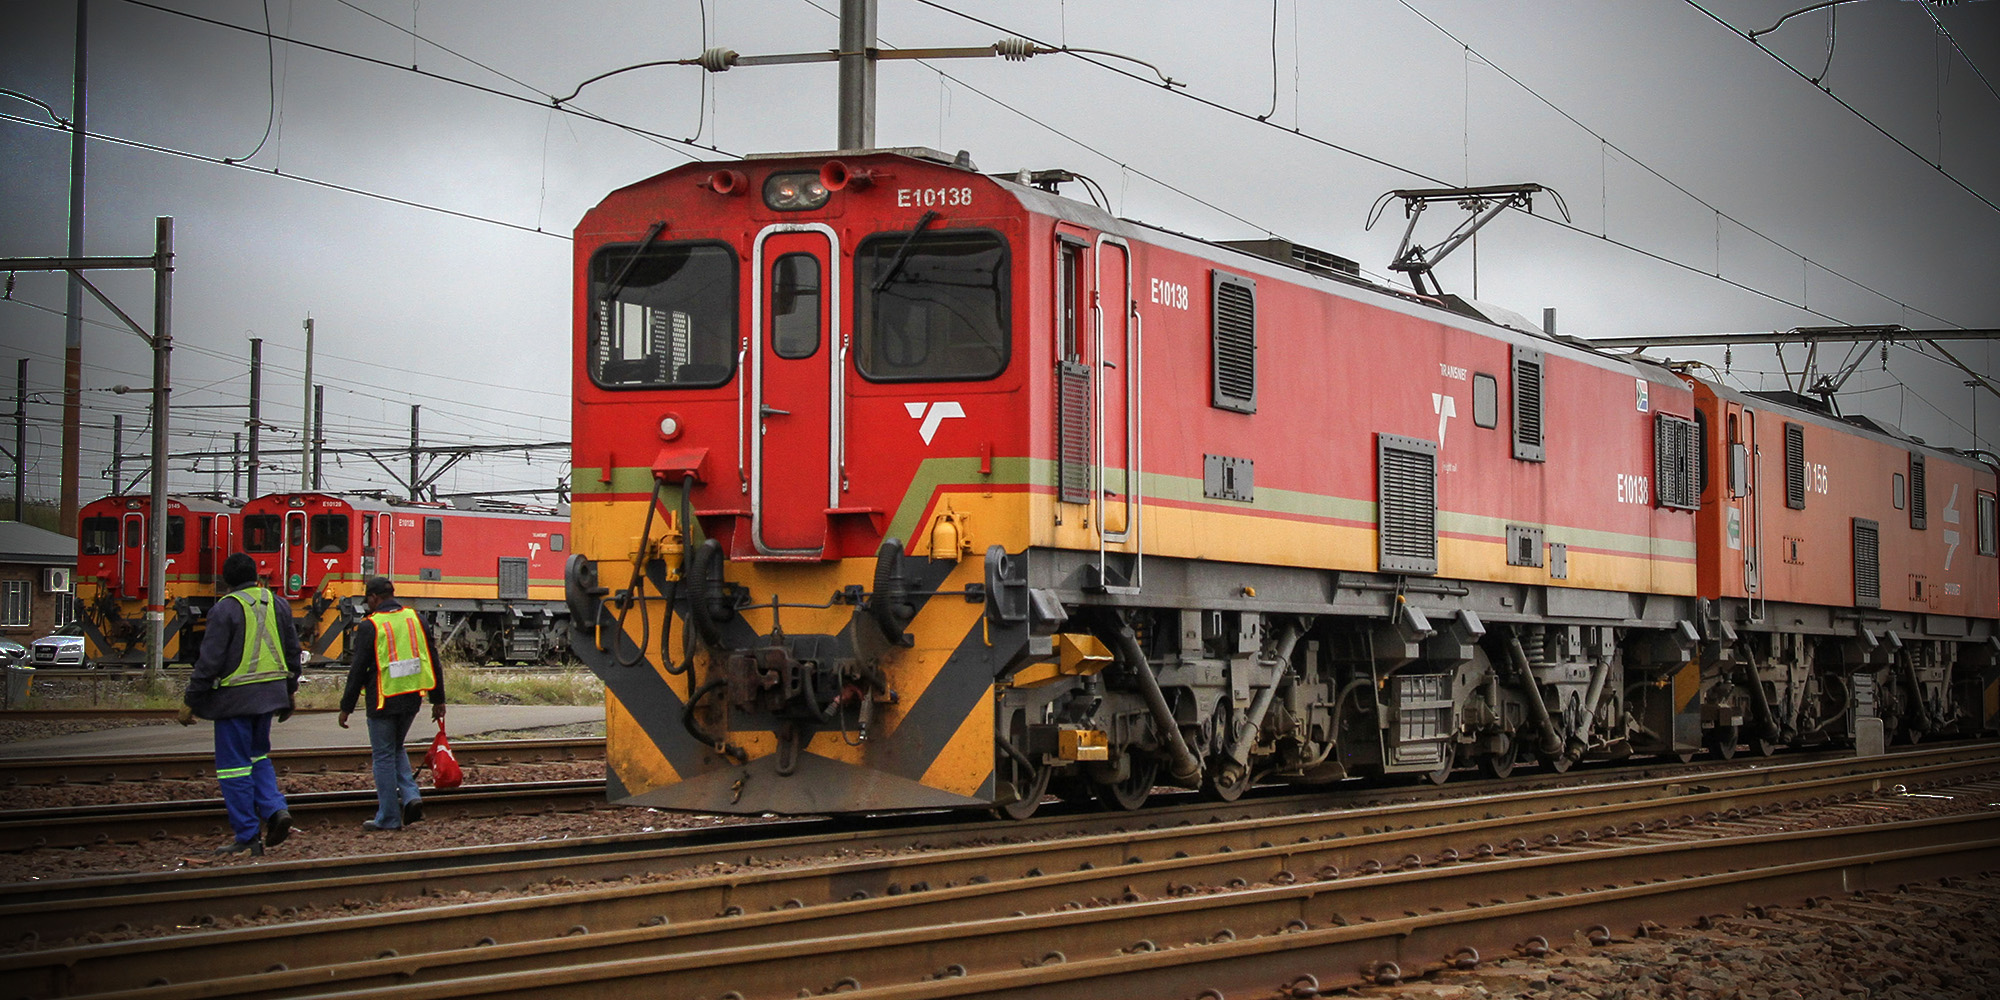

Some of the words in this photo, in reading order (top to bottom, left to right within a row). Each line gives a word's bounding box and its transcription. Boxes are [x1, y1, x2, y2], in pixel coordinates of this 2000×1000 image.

[897, 187, 972, 207] E10138
[1151, 277, 1189, 311] E10138
[1617, 473, 1649, 505] E10138
[1813, 463, 1828, 495] 156
